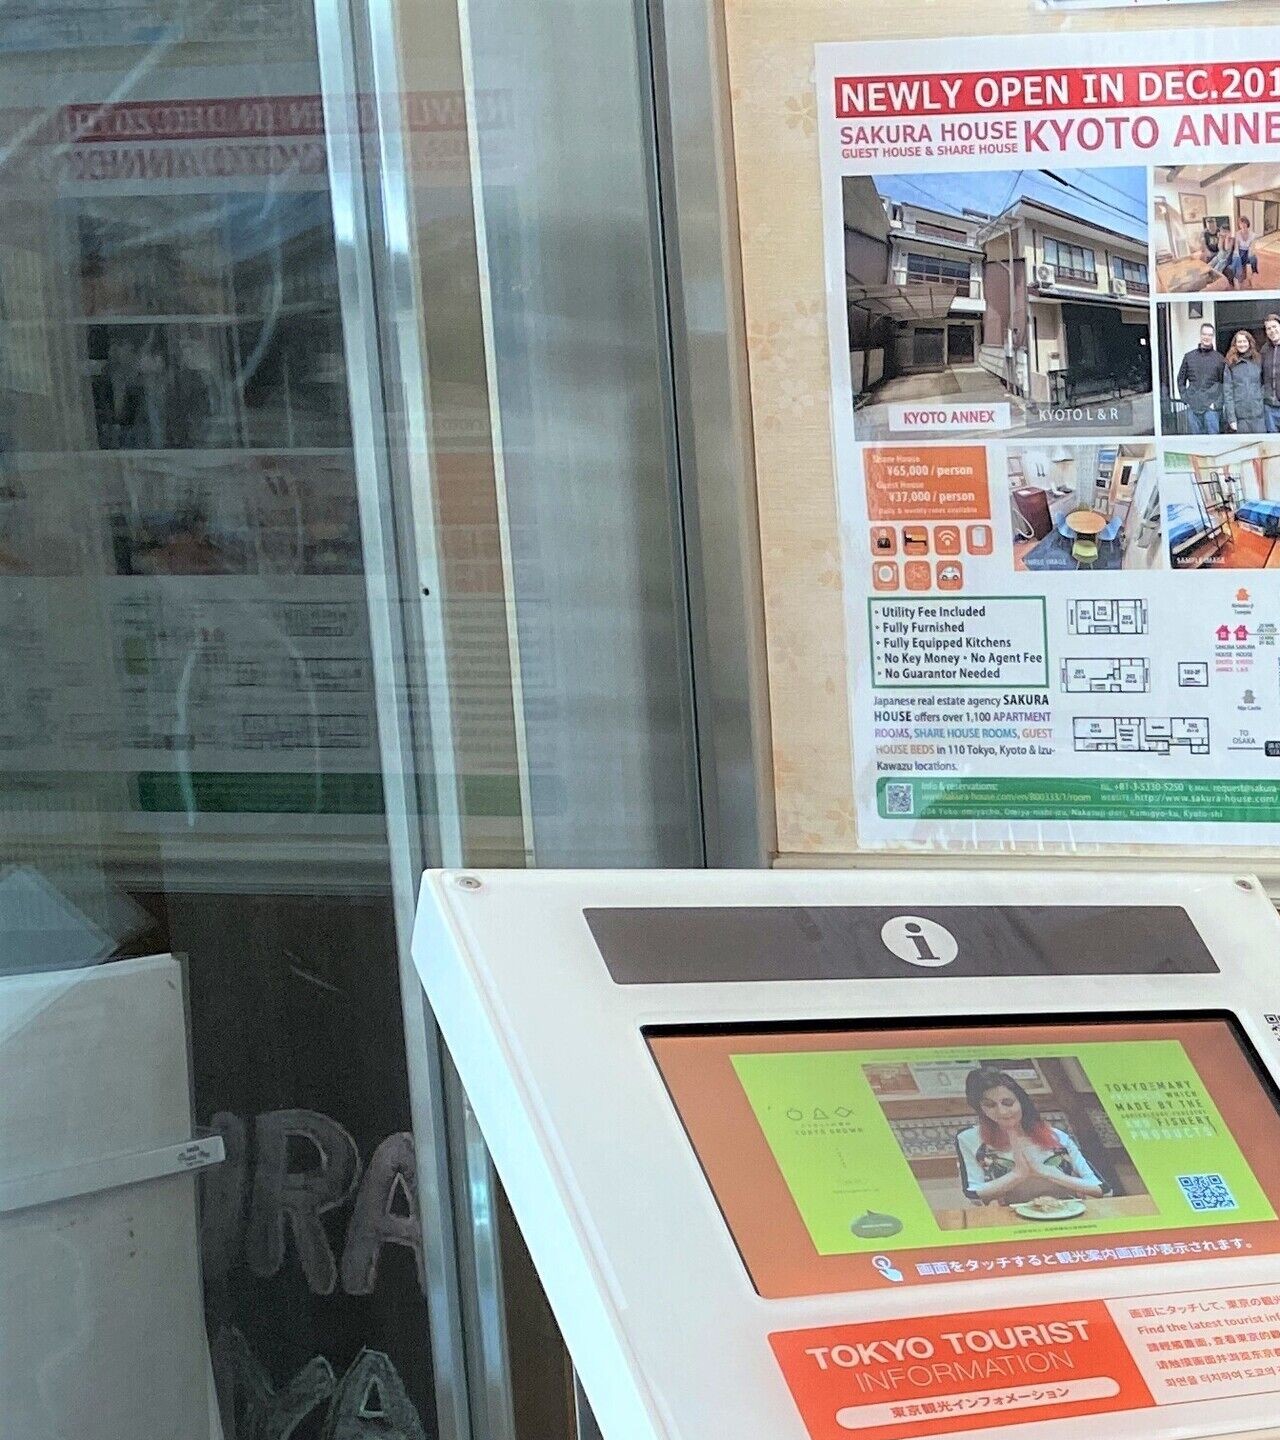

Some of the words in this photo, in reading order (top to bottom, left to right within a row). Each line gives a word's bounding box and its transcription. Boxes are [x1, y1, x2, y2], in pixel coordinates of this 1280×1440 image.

[841, 77, 969, 114] NEWLY
[975, 73, 1069, 108] OPEN
[1083, 73, 1124, 104] IN
[840, 124, 933, 144] SAKURA
[940, 120, 1017, 142] HOUSE
[1025, 116, 1159, 153] KYOTO
[903, 411, 947, 425] KYOTO
[950, 410, 995, 423] ANNEX
[882, 606, 917, 620] Utility
[921, 606, 939, 617] Fee
[942, 605, 986, 617] Included
[883, 622, 908, 635] Fully
[911, 621, 965, 633] Furnished
[1137, 1325, 1164, 1335] Find
[1166, 1323, 1186, 1332] the
[1188, 1319, 1223, 1330] latest
[1224, 1315, 1264, 1327] tourist
[805, 1336, 934, 1371] TOKYO
[940, 1320, 1090, 1354] TOURIST
[855, 1350, 1075, 1393] INFORMATION
[892, 1386, 1070, 1418] 東京観光インフォメーション
